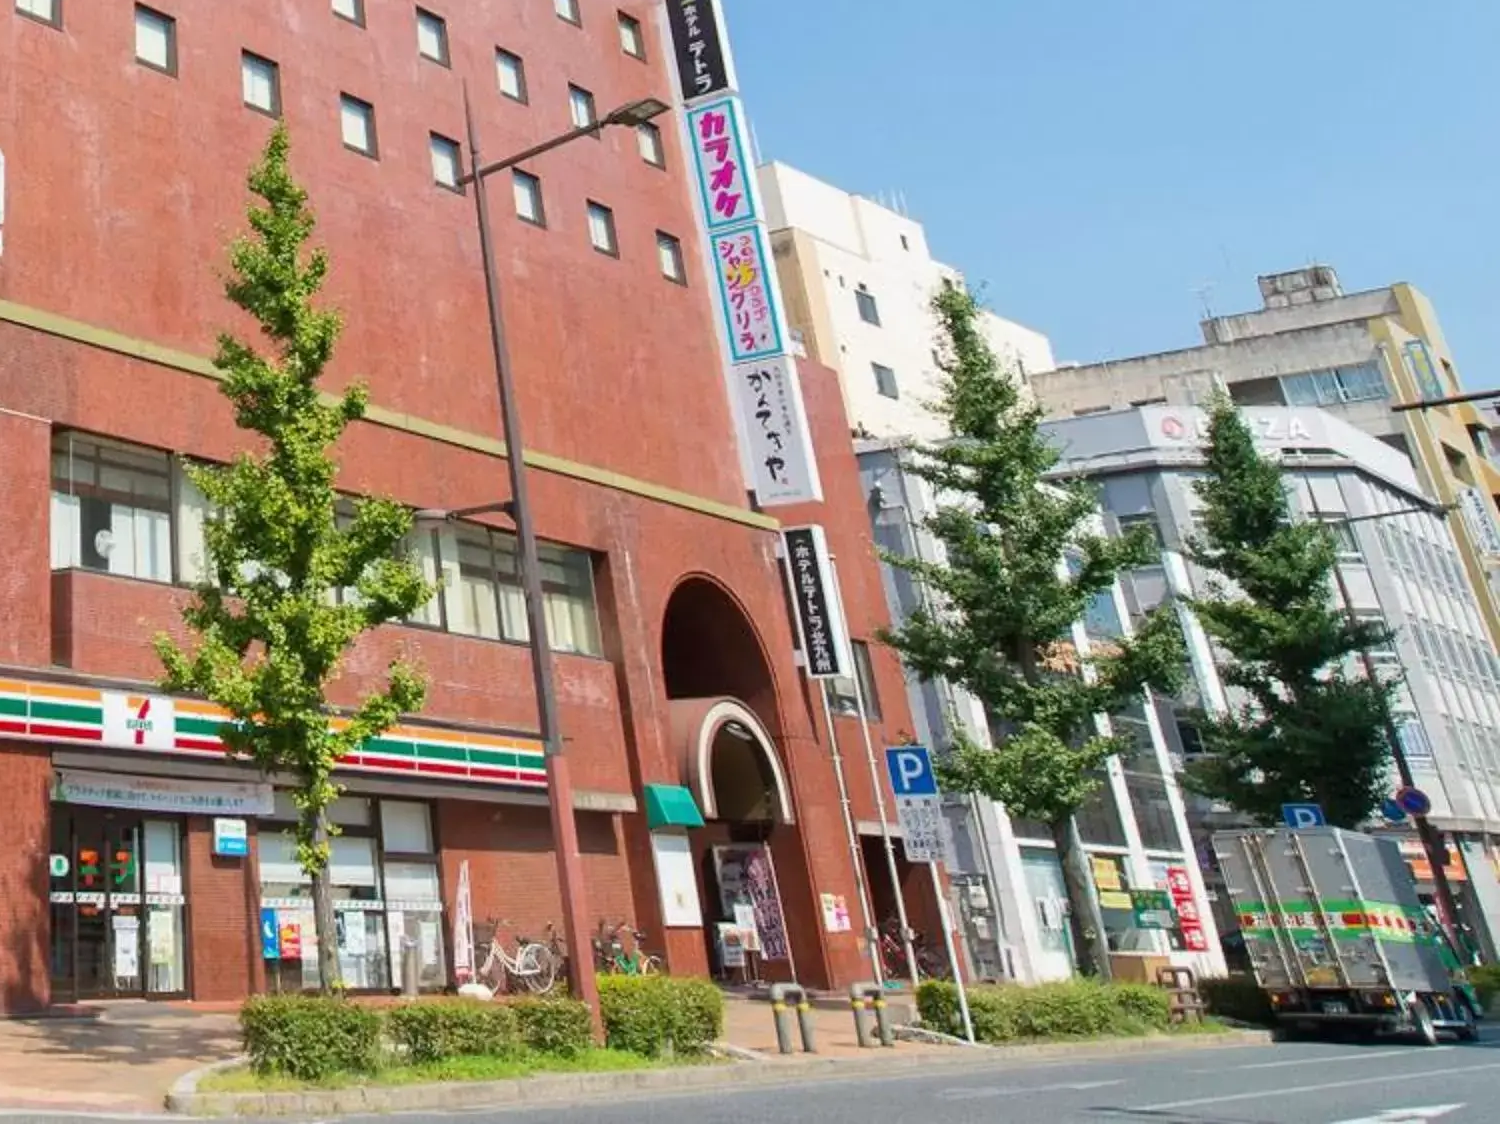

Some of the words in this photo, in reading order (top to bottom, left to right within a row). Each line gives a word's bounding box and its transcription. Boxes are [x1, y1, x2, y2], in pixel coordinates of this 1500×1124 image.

[683, 5, 701, 38] ホテル
[689, 39, 713, 95] テトラ
[699, 111, 742, 219] カラオケ
[795, 546, 832, 673] ホテルテトラ北九州
[897, 752, 924, 791] P
[1294, 808, 1318, 828] P
